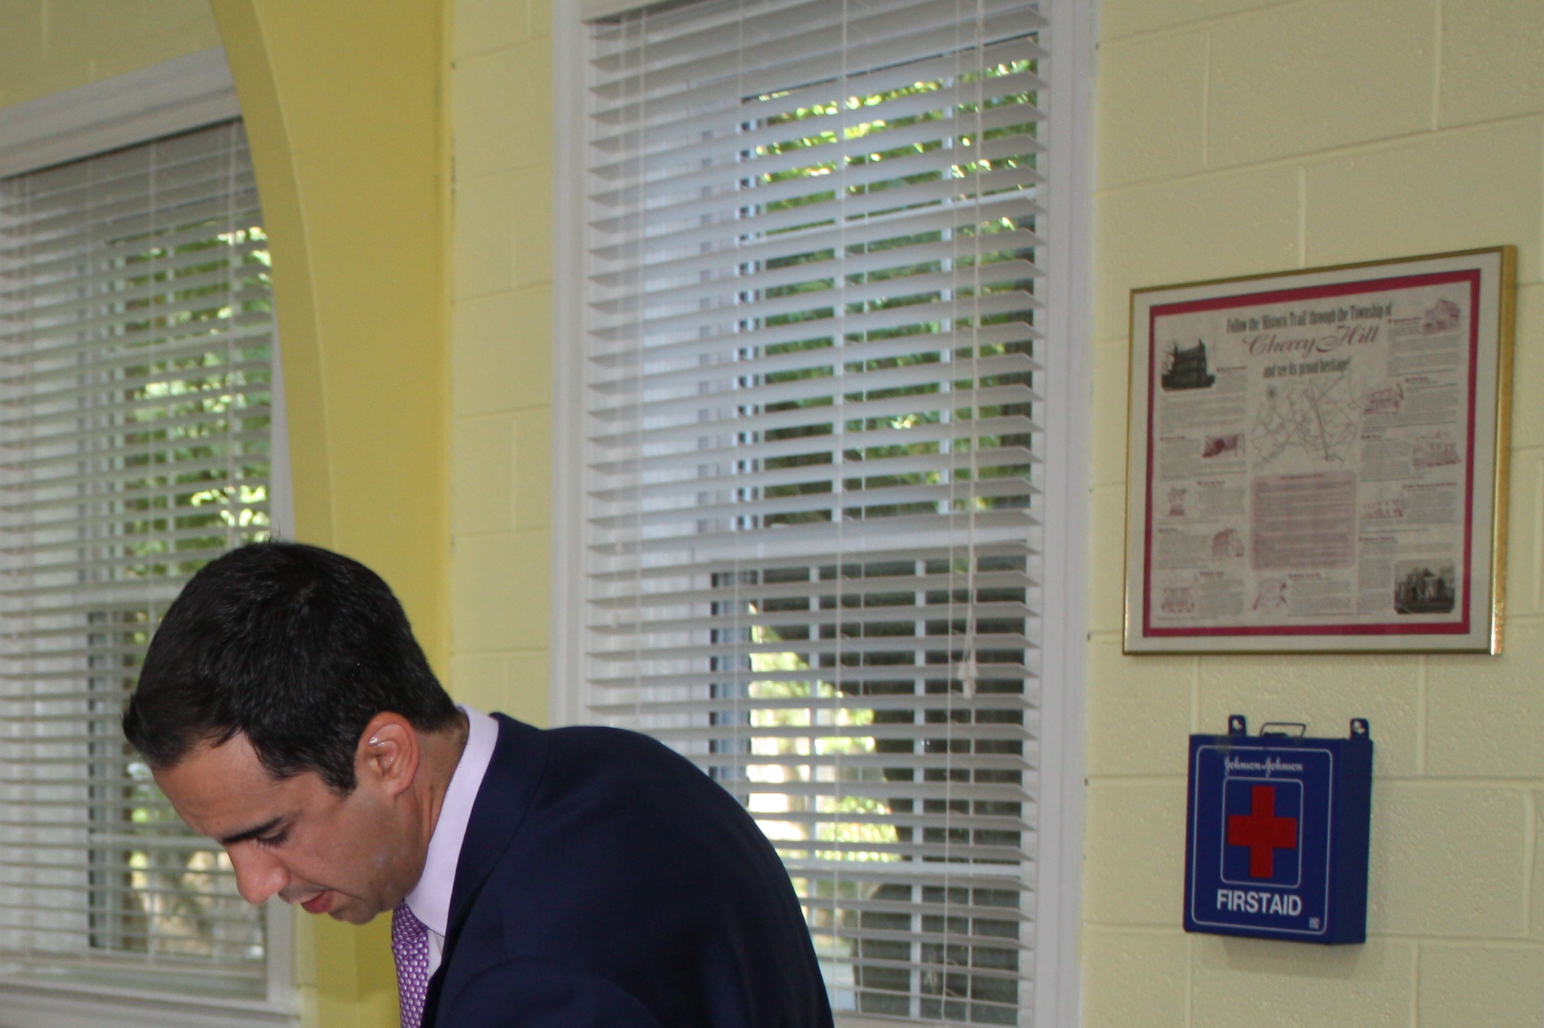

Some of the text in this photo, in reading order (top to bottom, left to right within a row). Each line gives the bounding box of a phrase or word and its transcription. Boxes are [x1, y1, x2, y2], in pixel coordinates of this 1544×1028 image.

[1227, 318, 1247, 333] Follow
[1249, 317, 1259, 331] the
[1309, 308, 1336, 325] through
[1337, 307, 1348, 322] the
[1350, 303, 1383, 320] Township
[1385, 302, 1393, 316] of
[1243, 333, 1316, 359] Cherry
[1316, 324, 1380, 353] Hill
[1263, 363, 1276, 377] and
[1224, 755, 1261, 777] Johnson
[1265, 756, 1304, 778] Johnson
